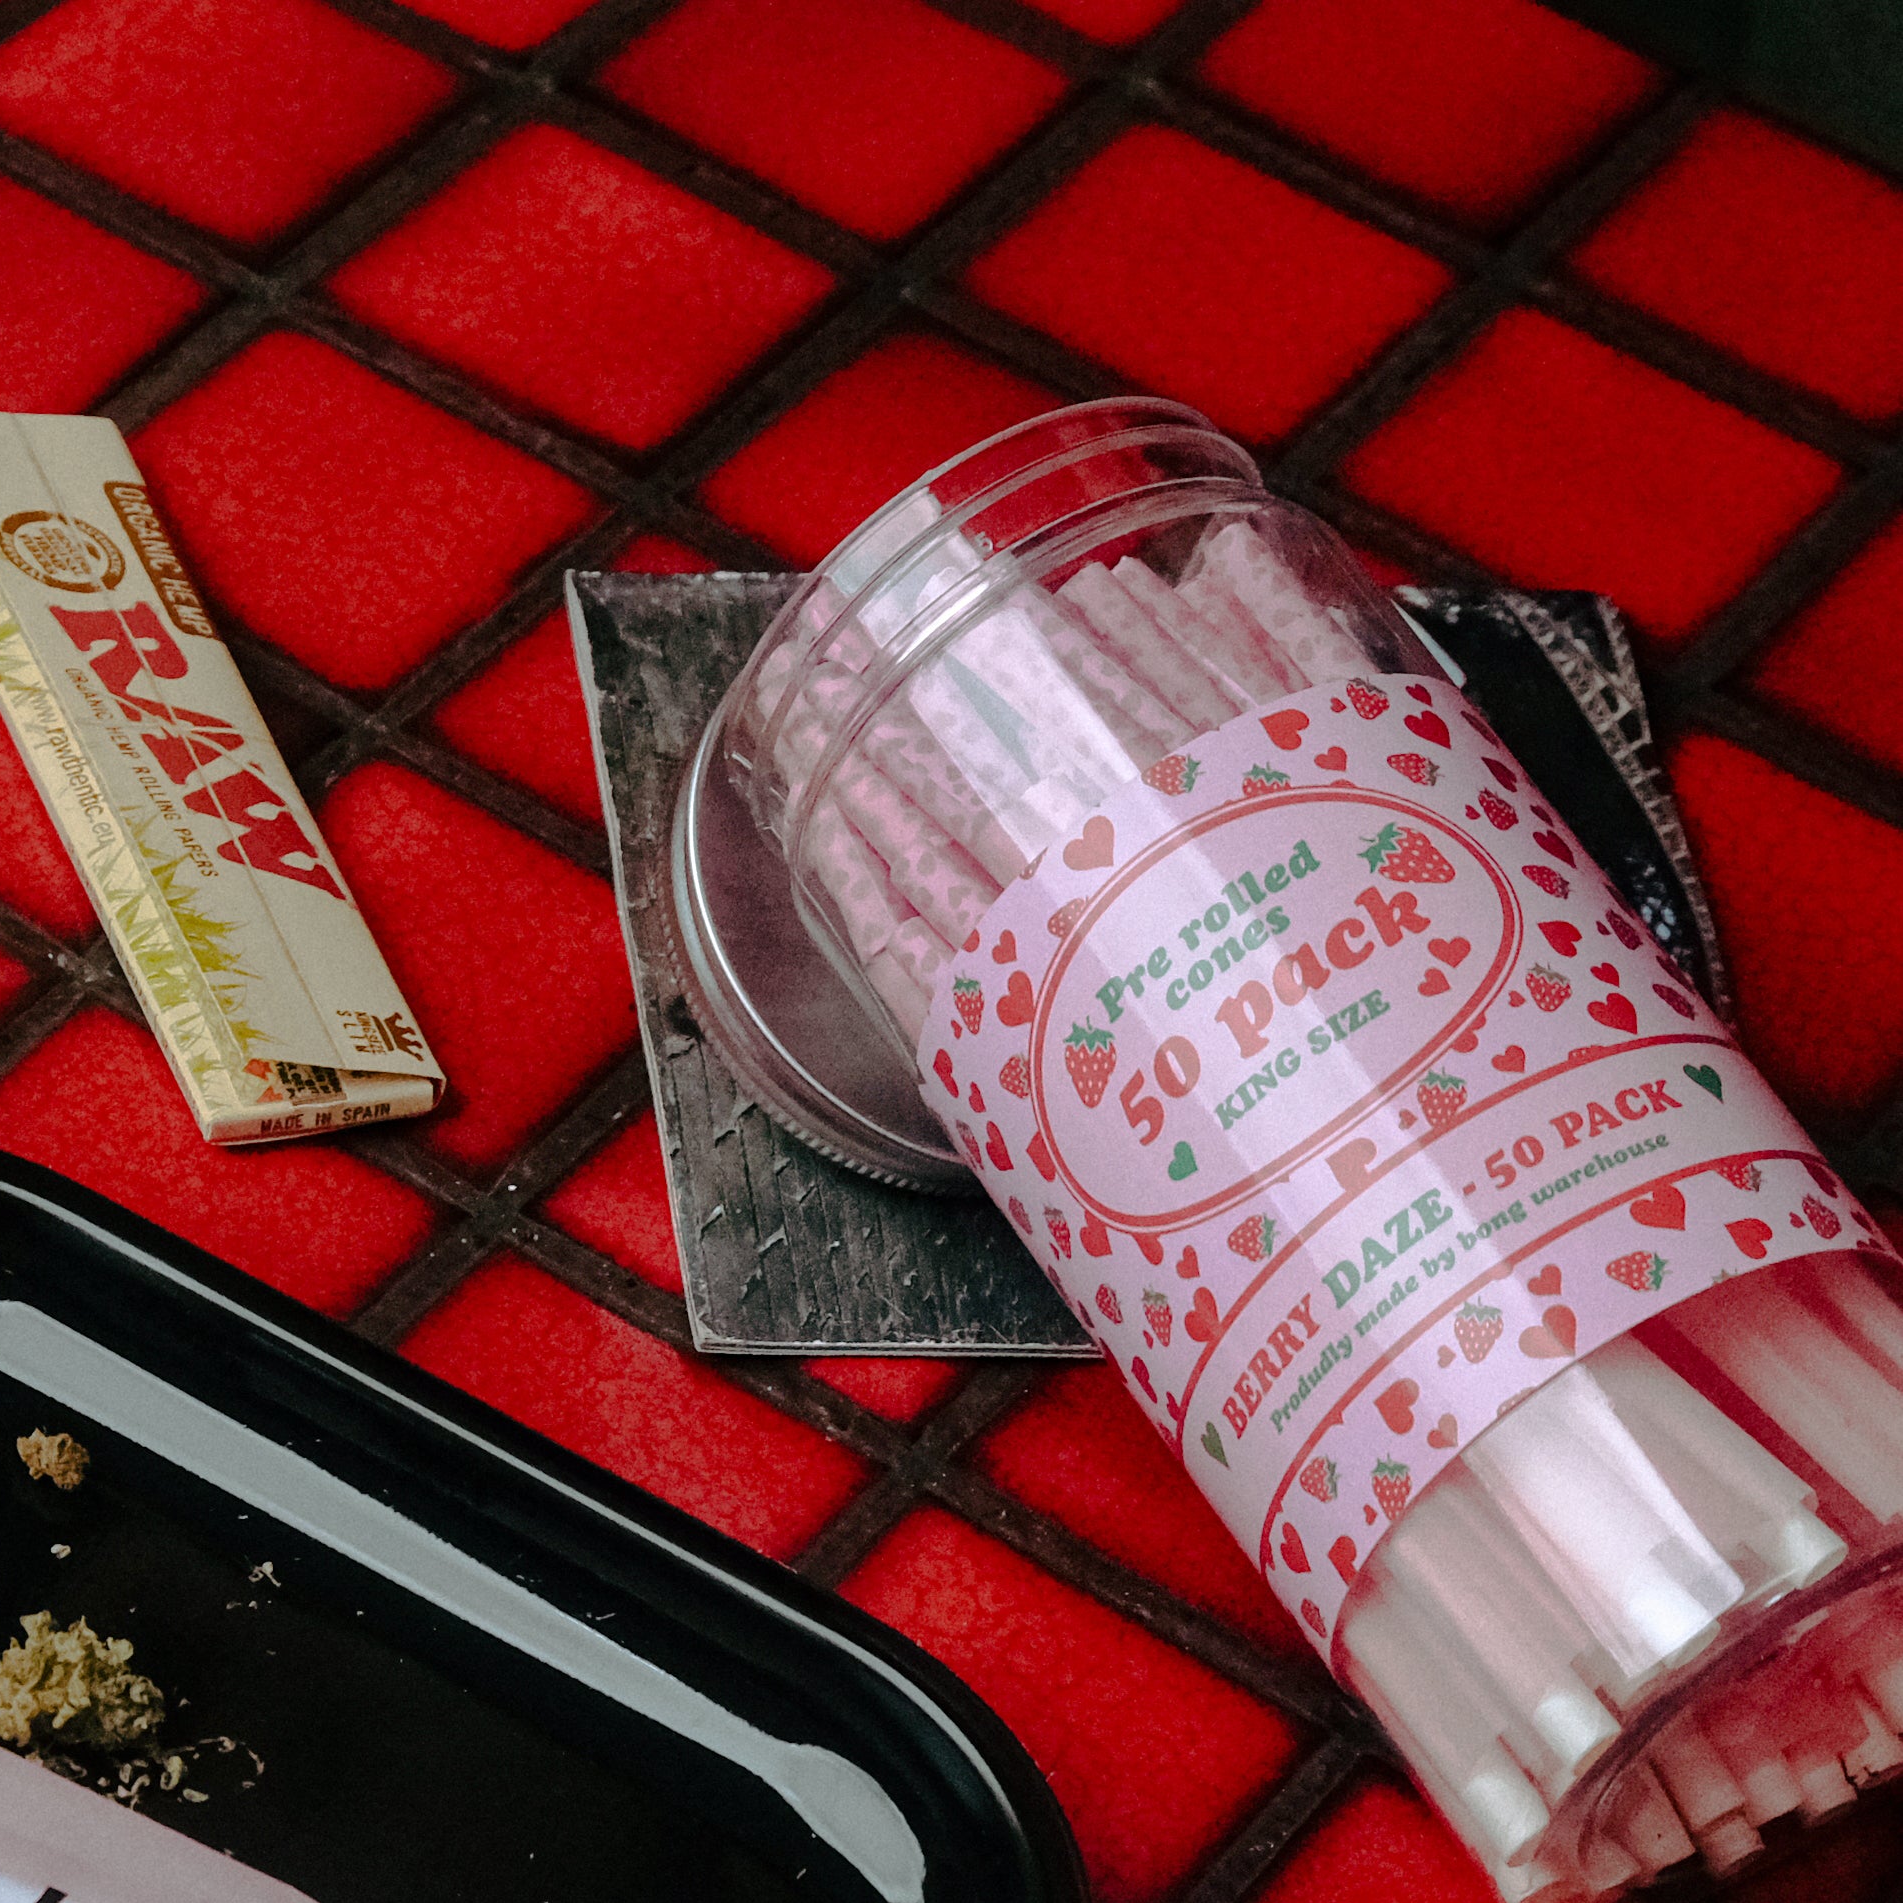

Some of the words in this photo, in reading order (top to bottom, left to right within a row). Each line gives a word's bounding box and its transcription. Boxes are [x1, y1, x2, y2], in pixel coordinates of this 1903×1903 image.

[113, 486, 183, 573] ORGANIC
[161, 576, 214, 637] HEMP
[49, 600, 348, 901] RAW
[64, 667, 113, 722] ORGANIC
[106, 724, 141, 760] HEMP
[133, 765, 182, 822] ROLLING
[174, 827, 219, 878] PAPERS
[1095, 945, 1173, 1024] Pre
[1178, 838, 1321, 951] rolled
[1119, 1034, 1201, 1147] 50
[1214, 885, 1431, 1059] pack
[1166, 905, 1291, 1011] cones
[260, 1113, 305, 1134] MADE
[315, 1111, 333, 1127] IN
[342, 1102, 391, 1122] SPAIN
[1213, 1046, 1301, 1131] KING
[1306, 988, 1391, 1056] SIZE
[1221, 1292, 1321, 1440] BERRY
[1322, 1187, 1454, 1309] DAZE
[1484, 1134, 1545, 1190] 50
[1549, 1079, 1683, 1149] PACK
[1354, 1274, 1419, 1338] made
[1425, 1245, 1456, 1279] by
[1456, 1199, 1528, 1253] bong
[1530, 1132, 1670, 1204] warehouse
